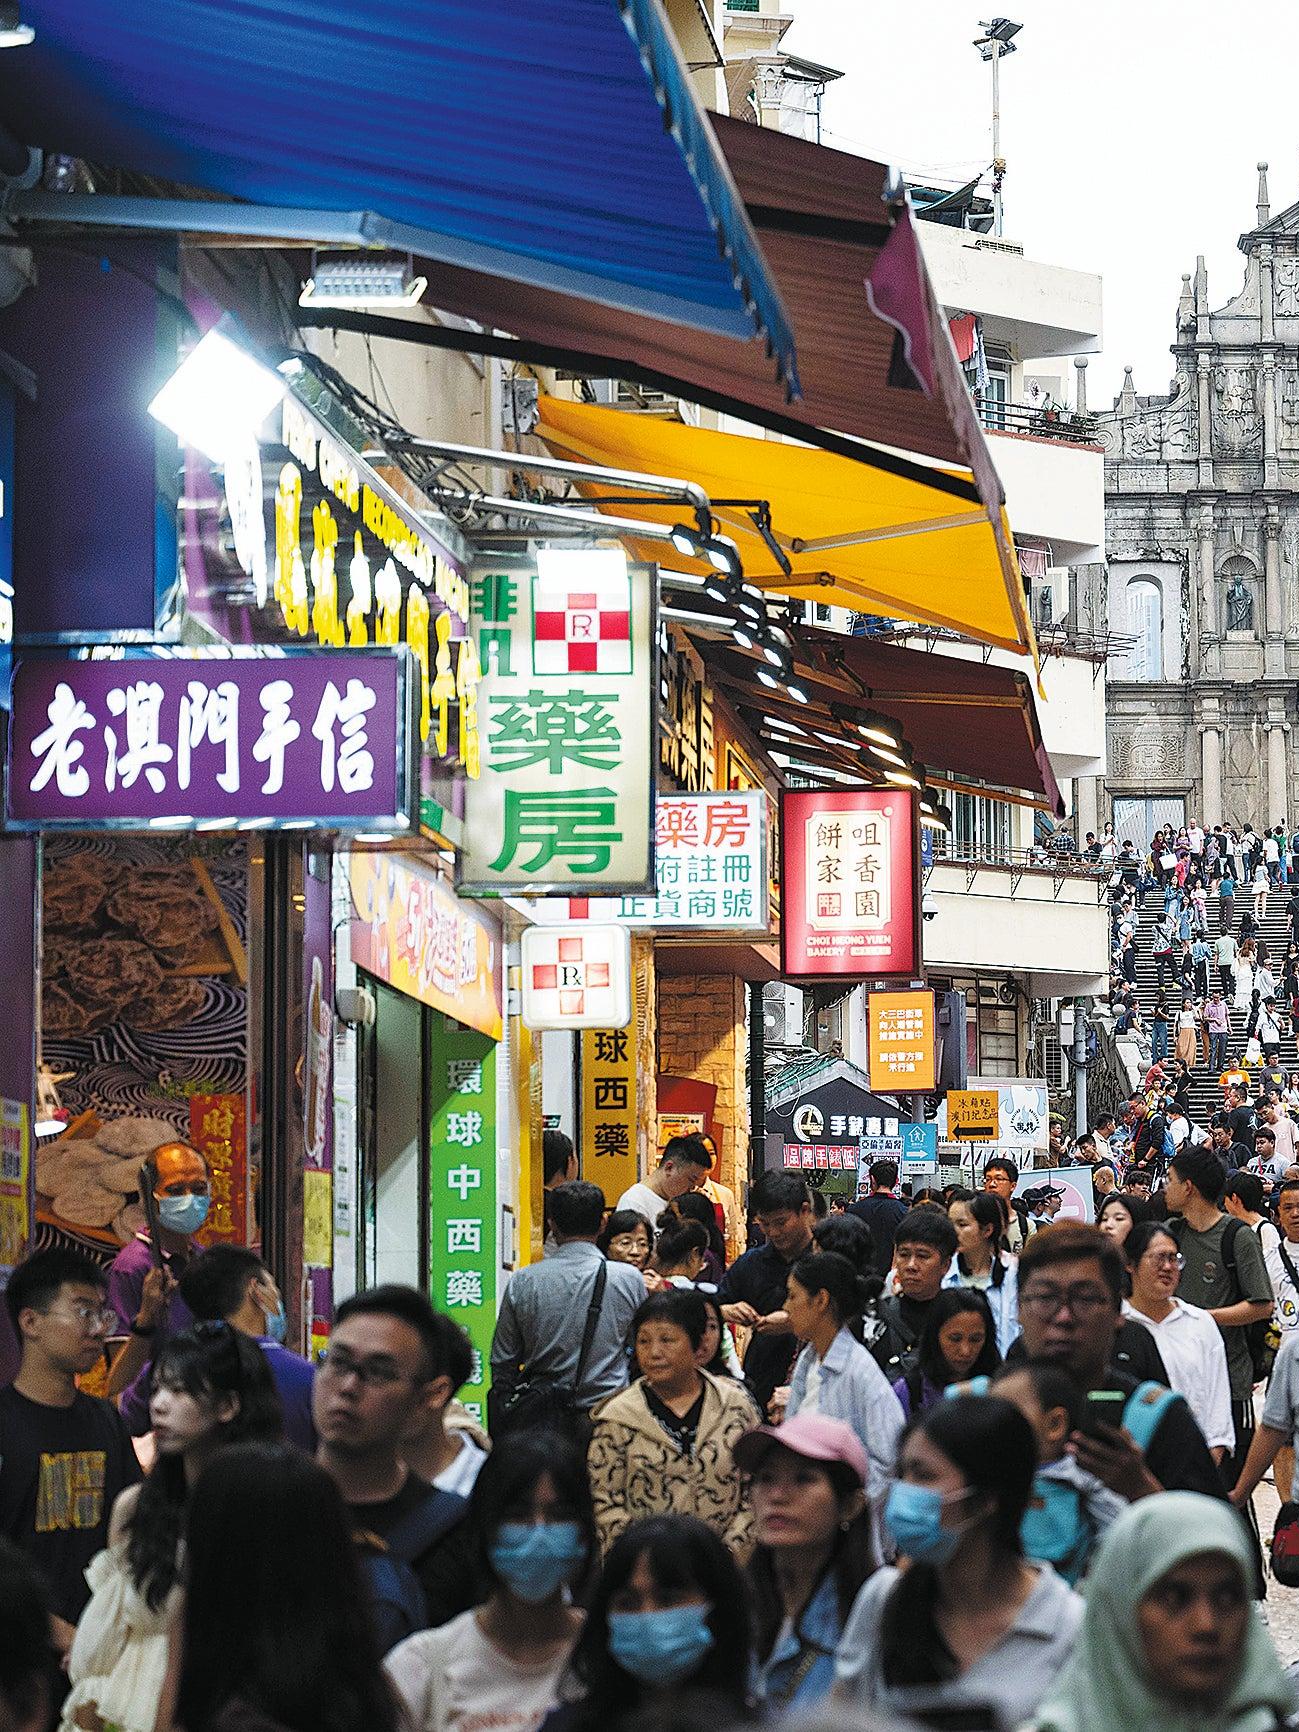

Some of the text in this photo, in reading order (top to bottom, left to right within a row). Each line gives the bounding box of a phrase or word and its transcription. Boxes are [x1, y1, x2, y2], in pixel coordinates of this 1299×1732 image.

[29, 677, 378, 796] 老澳門手信
[488, 689, 623, 874] 藥房
[656, 801, 750, 848] 藥房
[815, 822, 844, 884] 餅家
[852, 821, 882, 918] 咀香園
[806, 934, 892, 946] CHOI HEONG YUEN
[806, 946, 846, 958] BAKERY
[593, 1030, 629, 1158] 球西藥
[446, 1058, 482, 1306] 環球中西藥
